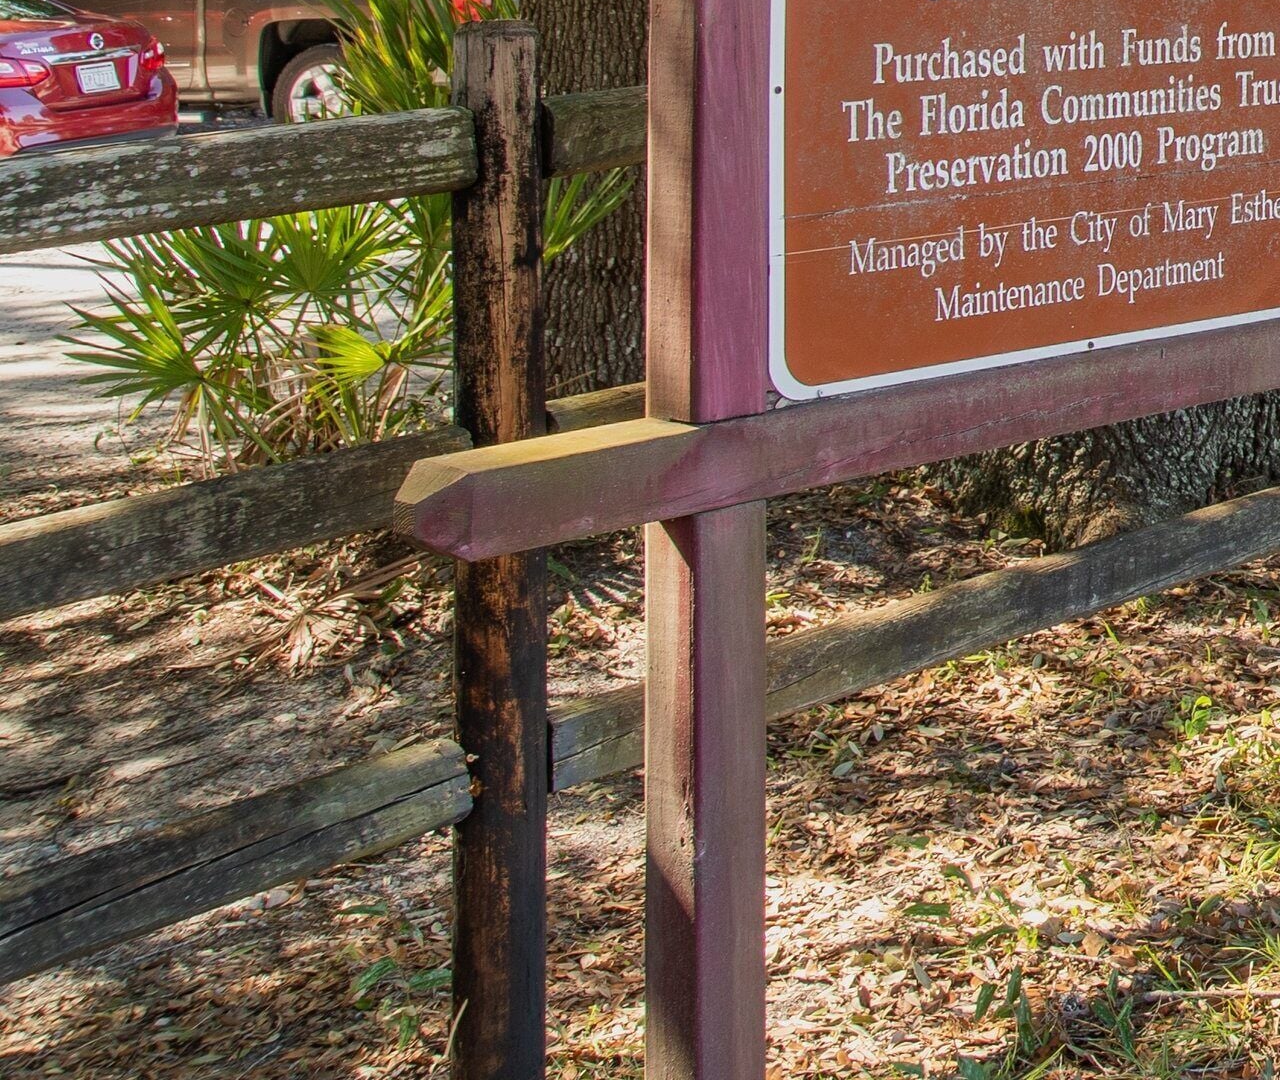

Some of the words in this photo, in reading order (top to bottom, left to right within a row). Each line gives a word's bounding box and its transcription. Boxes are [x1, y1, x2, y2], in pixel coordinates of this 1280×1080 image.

[872, 34, 1025, 84] Purchased
[1043, 32, 1105, 73] with
[1121, 25, 1201, 66] Funds
[1215, 22, 1275, 61] from
[842, 101, 901, 142] The
[920, 88, 1024, 135] Florida
[1041, 75, 1221, 124] Communities
[885, 139, 1068, 194] Preservation
[1084, 130, 1143, 172] 2000
[1157, 125, 1264, 172] Program
[849, 227, 964, 277] Managed
[979, 223, 1008, 268] by
[1022, 216, 1057, 252] the
[1070, 212, 1117, 253] City
[1130, 203, 1151, 237] of
[1163, 197, 1218, 238] Mary
[934, 272, 1085, 321] Maintenance
[1098, 252, 1225, 303] Department
